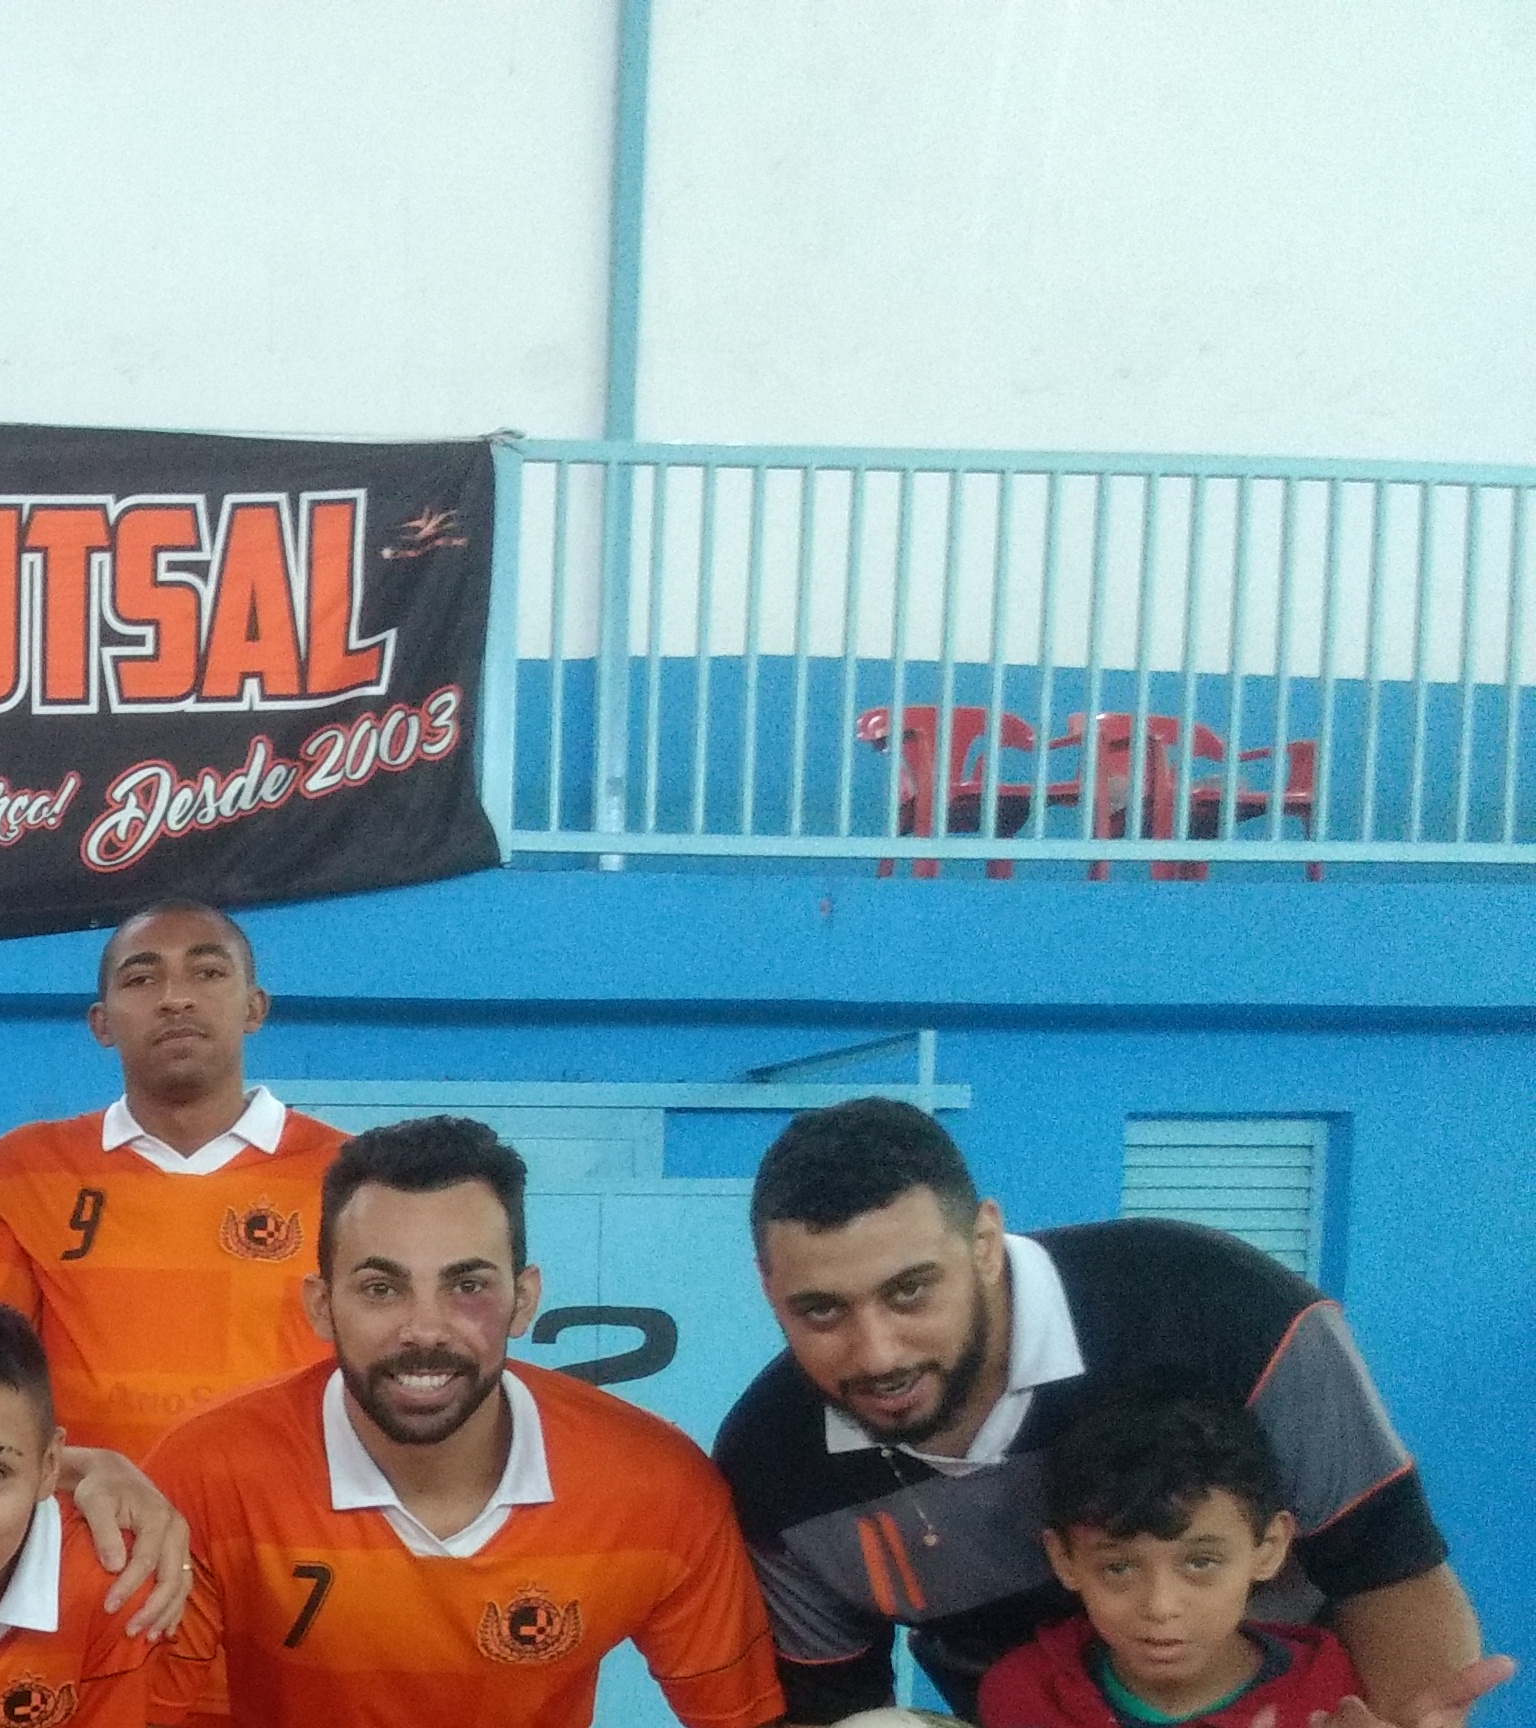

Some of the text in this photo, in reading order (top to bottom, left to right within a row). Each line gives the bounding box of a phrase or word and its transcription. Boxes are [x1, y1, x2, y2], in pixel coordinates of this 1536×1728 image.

[85, 689, 461, 868] Desde 2003
[59, 1186, 105, 1261] 9
[283, 1563, 336, 1651] 7
